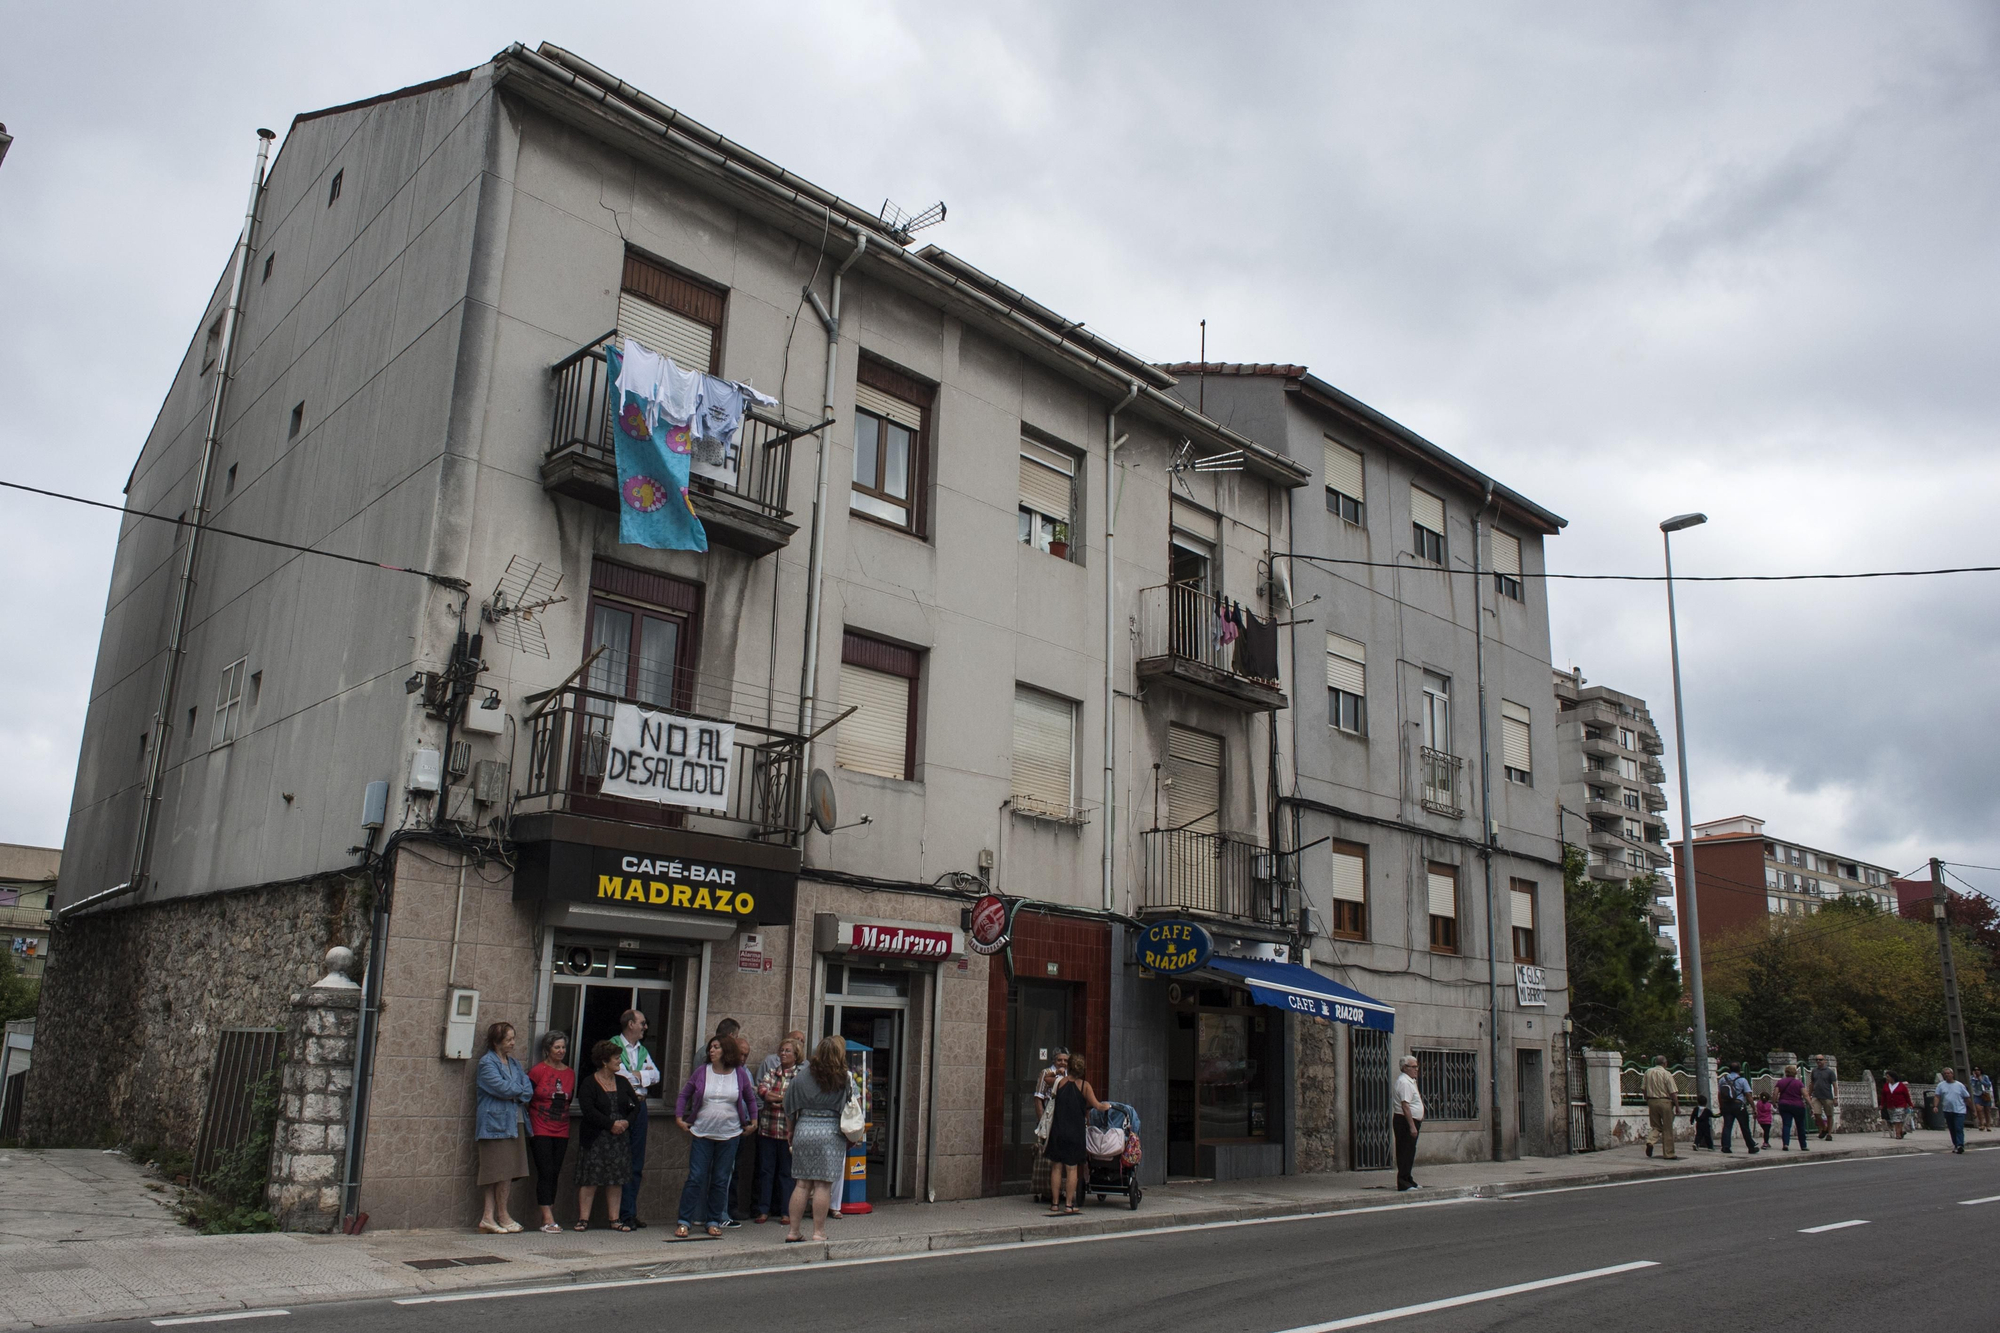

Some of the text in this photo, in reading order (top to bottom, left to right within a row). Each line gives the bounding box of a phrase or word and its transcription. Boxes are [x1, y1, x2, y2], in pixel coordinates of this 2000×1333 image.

[640, 718, 728, 762] NO AL
[609, 747, 725, 795] DESALOJO
[622, 856, 736, 885] CAFÉ-BAR
[597, 875, 755, 914] MADRAZO
[852, 926, 947, 956] Madrazo
[1150, 925, 1192, 941] CAFE
[1145, 948, 1197, 970] RIAZOR
[1288, 995, 1364, 1024] CAFE RIAZOR
